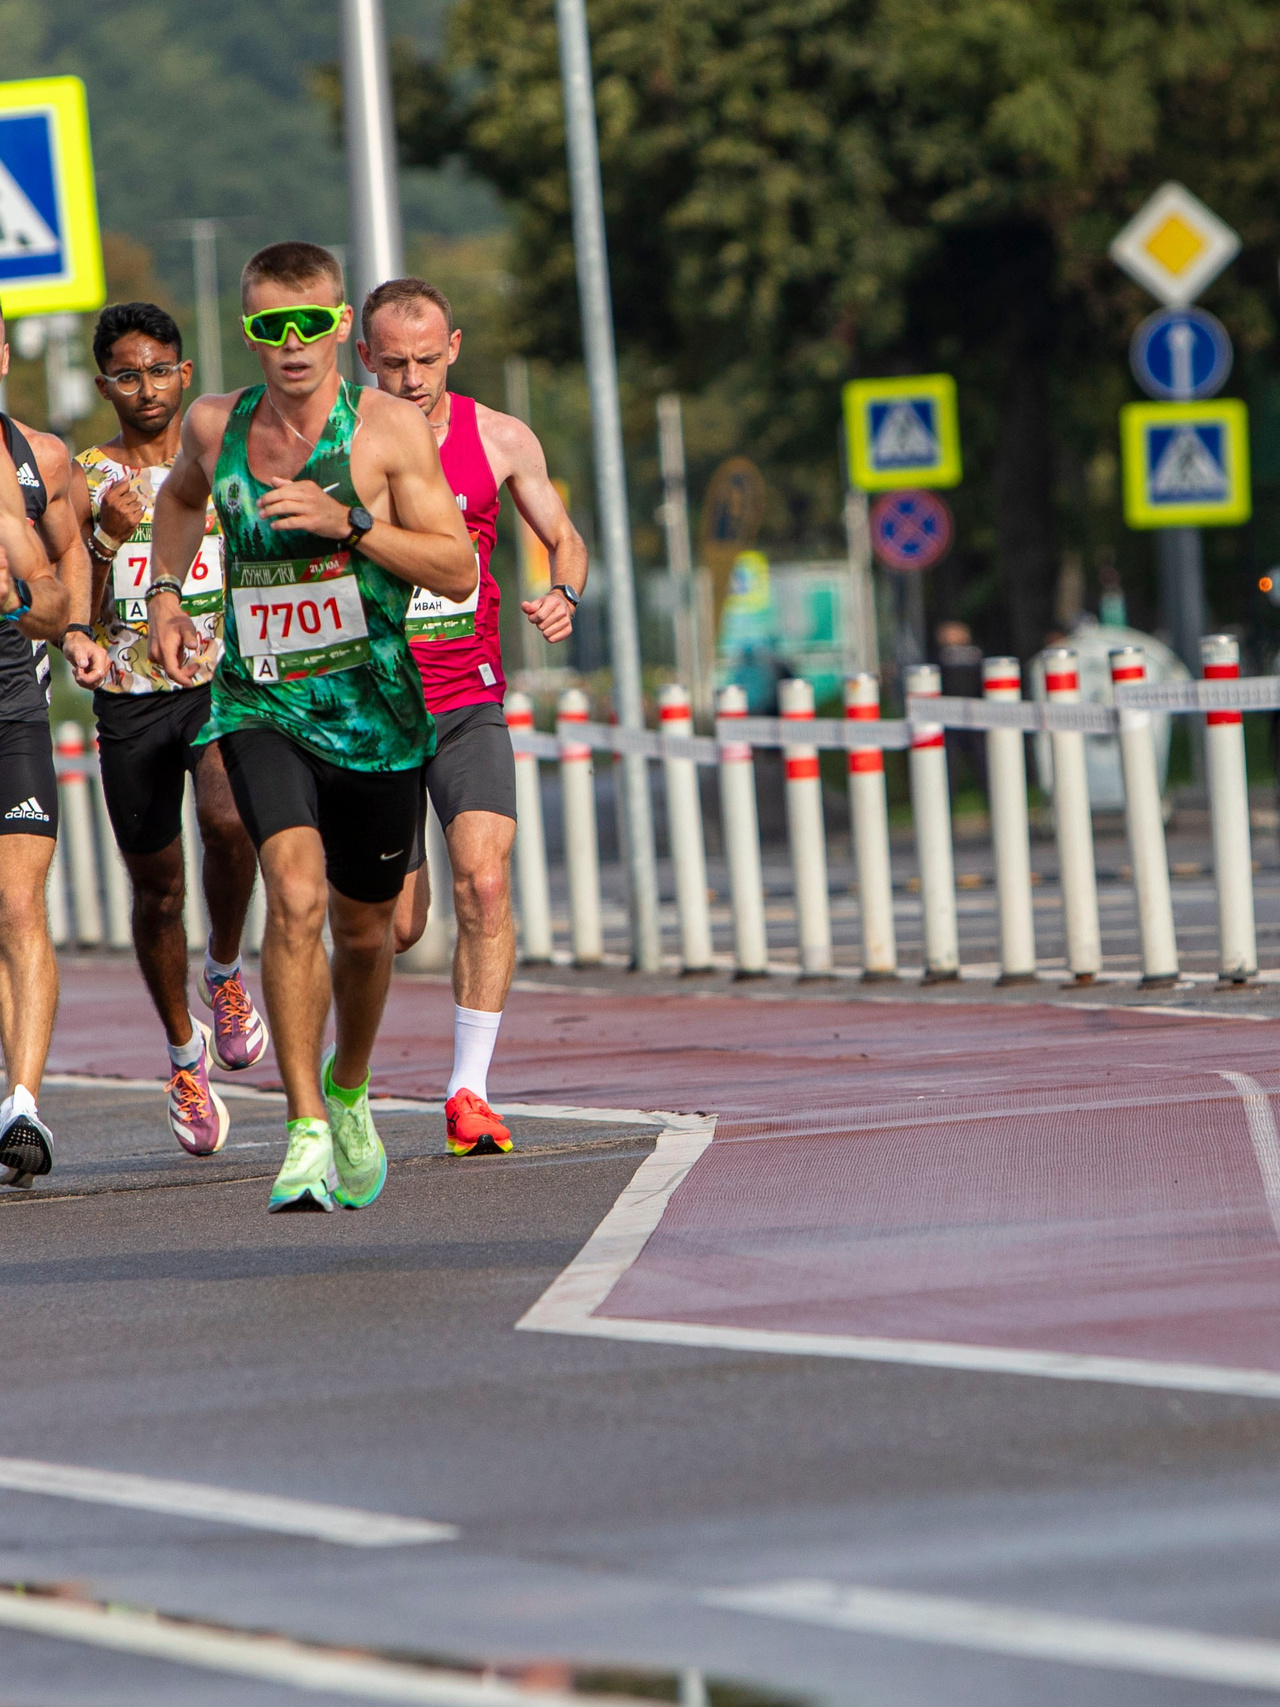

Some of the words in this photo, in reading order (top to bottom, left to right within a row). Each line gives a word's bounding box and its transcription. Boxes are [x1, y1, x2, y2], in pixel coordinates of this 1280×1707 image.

[128, 551, 209, 586] 76
[130, 601, 143, 617] A
[414, 601, 442, 611] ИВАН
[250, 596, 342, 640] 7701
[259, 659, 273, 677] A
[4, 810, 50, 822] adidas
